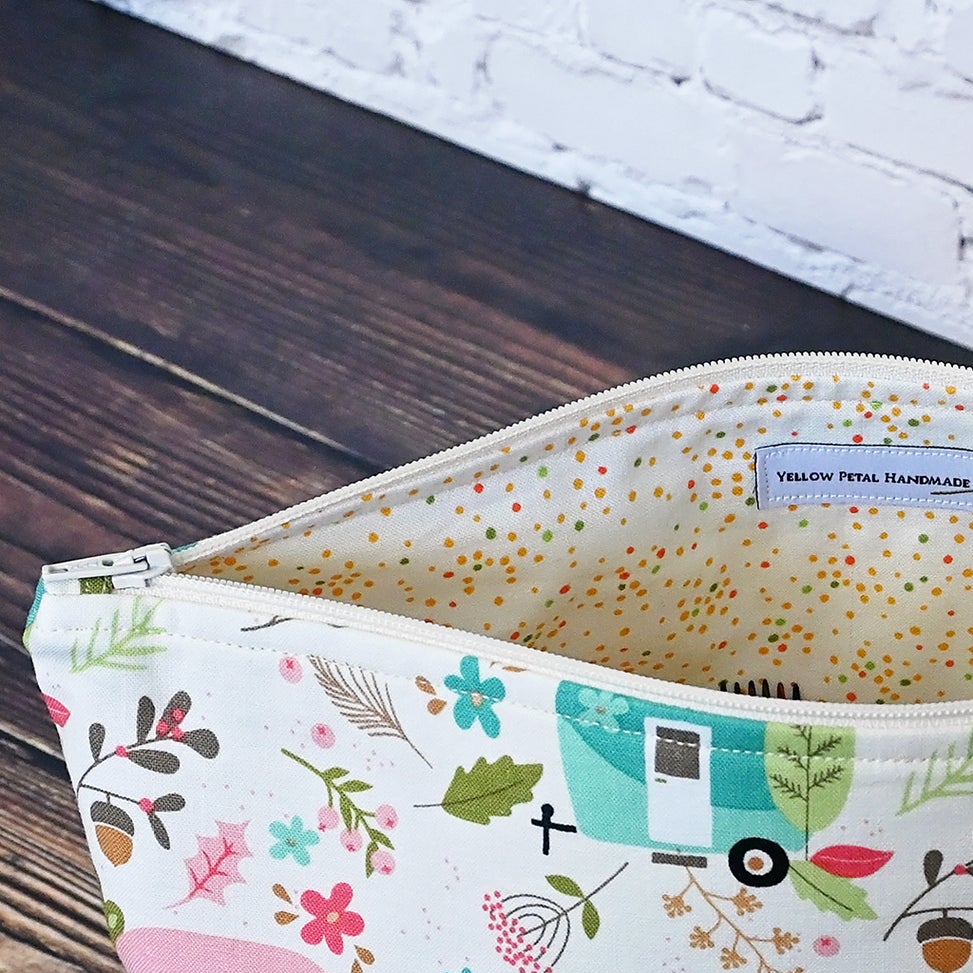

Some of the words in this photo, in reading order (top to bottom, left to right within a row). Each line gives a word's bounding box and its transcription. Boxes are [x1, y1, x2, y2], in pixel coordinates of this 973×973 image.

[777, 471, 834, 483] YELLOW
[839, 471, 880, 483] PETAL
[884, 472, 971, 488] HANDMADE
